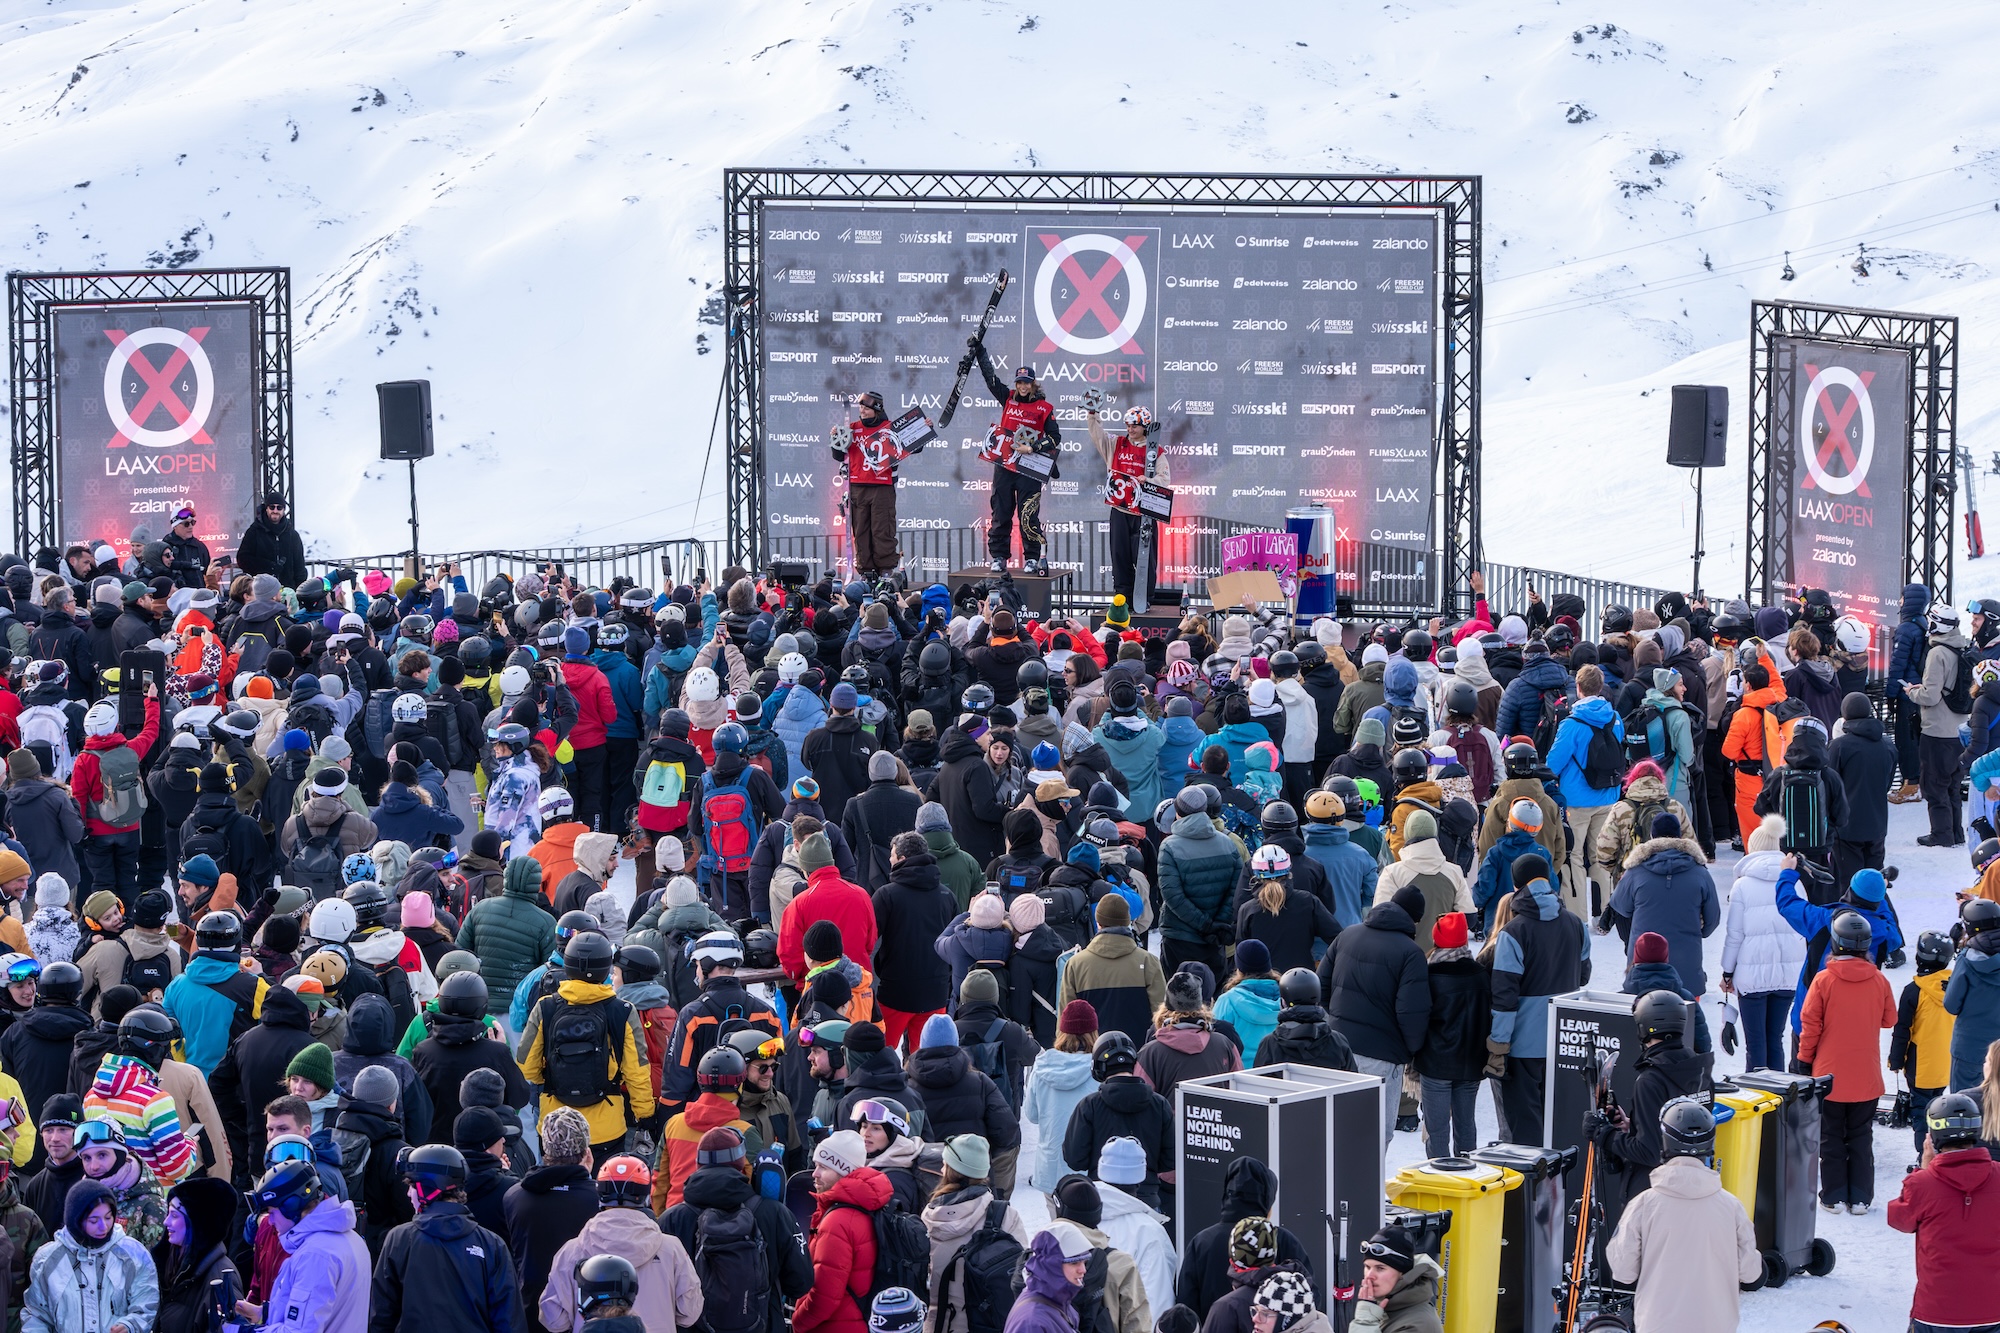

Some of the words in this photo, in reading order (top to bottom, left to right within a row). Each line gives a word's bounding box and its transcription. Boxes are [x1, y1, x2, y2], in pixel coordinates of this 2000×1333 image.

[769, 229, 820, 240] zalando
[979, 233, 1017, 243] SPORT
[1173, 234, 1214, 248] LAAX
[1249, 237, 1289, 247] Sunrise
[1313, 237, 1358, 246] edelweiss
[1373, 238, 1428, 249] zalando
[911, 273, 949, 283] SPORT
[1179, 277, 1219, 287] Sunrise
[1243, 278, 1288, 286] edelweiss
[1303, 279, 1357, 290] zalando
[1061, 289, 1067, 299] 2
[1114, 289, 1120, 300] 6
[845, 312, 882, 322] SPORT
[1173, 318, 1219, 326] edelweiss
[1233, 319, 1287, 330] zalando
[782, 353, 818, 362] SPORT
[1164, 360, 1218, 371] zalando
[1385, 364, 1426, 374] SPORT
[131, 382, 136, 393] 2
[182, 381, 188, 392] 6
[902, 394, 942, 408] LAAX
[1106, 394, 1117, 404] by
[1056, 407, 1122, 422] zalado
[1315, 404, 1355, 415] SPORT
[1818, 423, 1822, 434] 2
[1852, 426, 1857, 438] 6
[1246, 445, 1285, 456] SPORT
[776, 473, 813, 487] LAAX
[905, 478, 949, 487] edelweiss
[134, 485, 177, 496] presented
[179, 484, 190, 494] by
[1179, 485, 1217, 495] SPORT
[1376, 488, 1419, 502] LAAX
[783, 515, 820, 524] Sunrise
[898, 517, 950, 529] zalando
[1385, 530, 1425, 540] Sunrise
[1816, 533, 1844, 546] presented
[1846, 538, 1854, 548] by
[1224, 539, 1248, 562] SEND
[1252, 535, 1262, 554] IT
[1266, 537, 1295, 556] LARA
[1306, 554, 1329, 566] Bull
[1812, 548, 1856, 566] zalando
[1560, 1032, 1620, 1049] NOTING
[1186, 1105, 1222, 1122] LEAVE
[1186, 1119, 1241, 1140] NOTHING
[1186, 1132, 1234, 1152] BEHIND.
[819, 1150, 854, 1174] CANA
